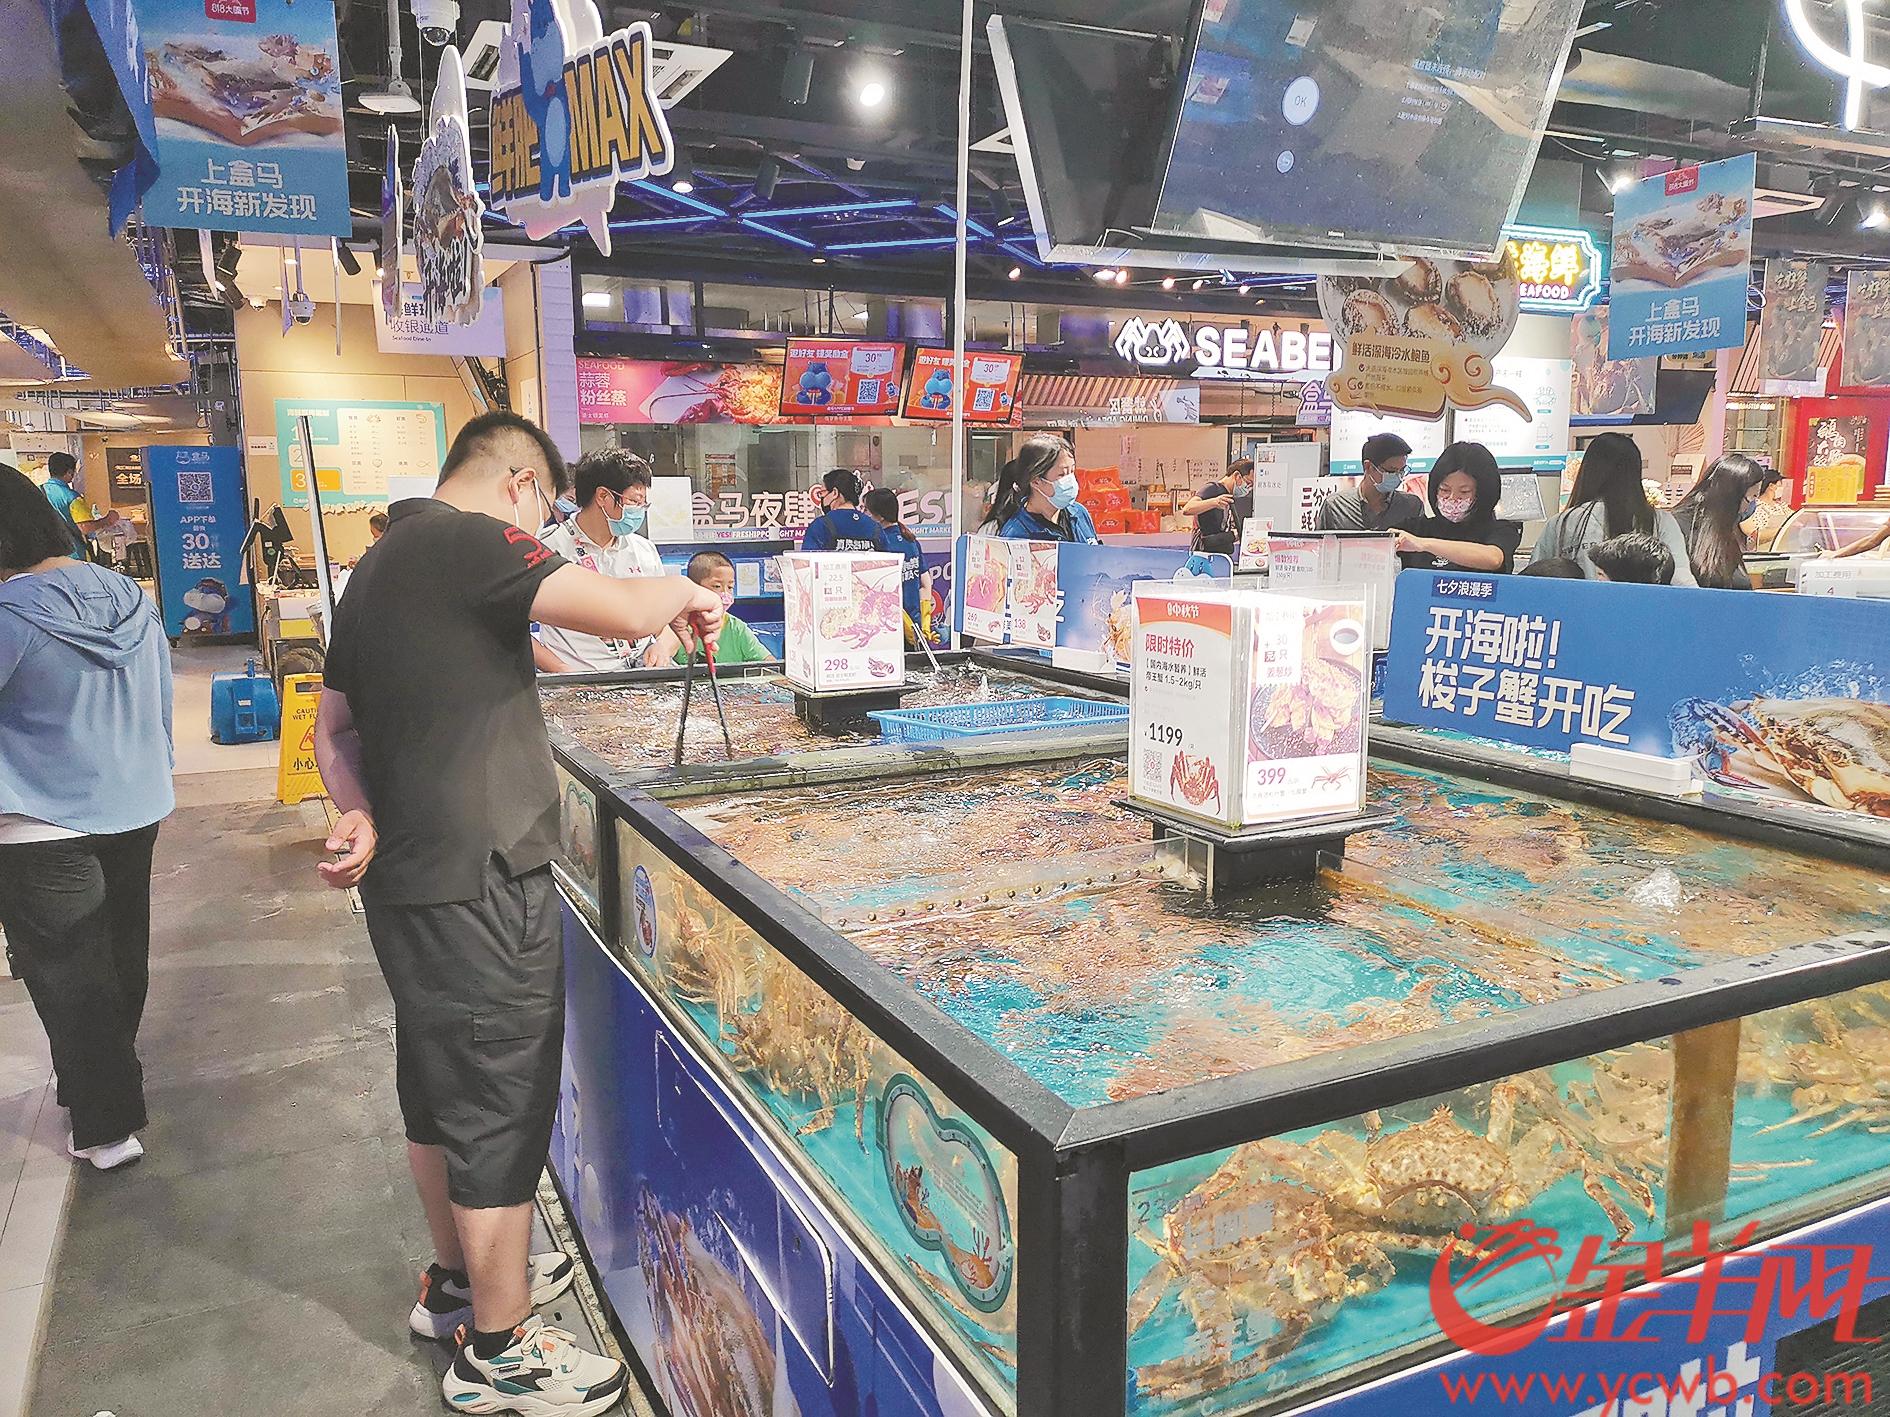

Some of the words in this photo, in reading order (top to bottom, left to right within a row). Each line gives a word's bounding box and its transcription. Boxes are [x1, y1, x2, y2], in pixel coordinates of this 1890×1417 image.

[564, 40, 664, 173] MAX
[1294, 96, 1308, 106] OK
[201, 158, 283, 189] 上盒马
[176, 186, 318, 221] 开海新发现
[1518, 282, 1572, 301] EAFOOD
[1644, 296, 1700, 323] 上盒马
[391, 319, 450, 335] 收银通道
[1628, 316, 1721, 348] 开海新发现
[1195, 325, 1342, 371] SEABE
[1351, 341, 1430, 364] 鲜活深海冷水鲍鱼
[578, 360, 625, 371] SEAFOOD
[865, 352, 877, 363] 30
[983, 363, 994, 373] 30
[579, 371, 611, 389] 蒜蓉
[580, 389, 627, 407] 粉丝蒸
[115, 472, 142, 485] 全场
[691, 491, 818, 529] 盒马夜肆
[179, 515, 217, 524] APP下单
[929, 527, 952, 535] MARKE
[181, 533, 210, 550] 30
[182, 552, 222, 569] 送达
[1435, 579, 1494, 599] 七夕浪漫季
[1145, 633, 1195, 659] 限时特价
[1424, 605, 1562, 669] 开海啦!
[824, 659, 849, 672] 298
[1417, 658, 1636, 745] 梭子蟹开吃
[296, 707, 318, 715] CAUTI
[293, 756, 319, 770] 小心
[1256, 767, 1287, 786] 399
